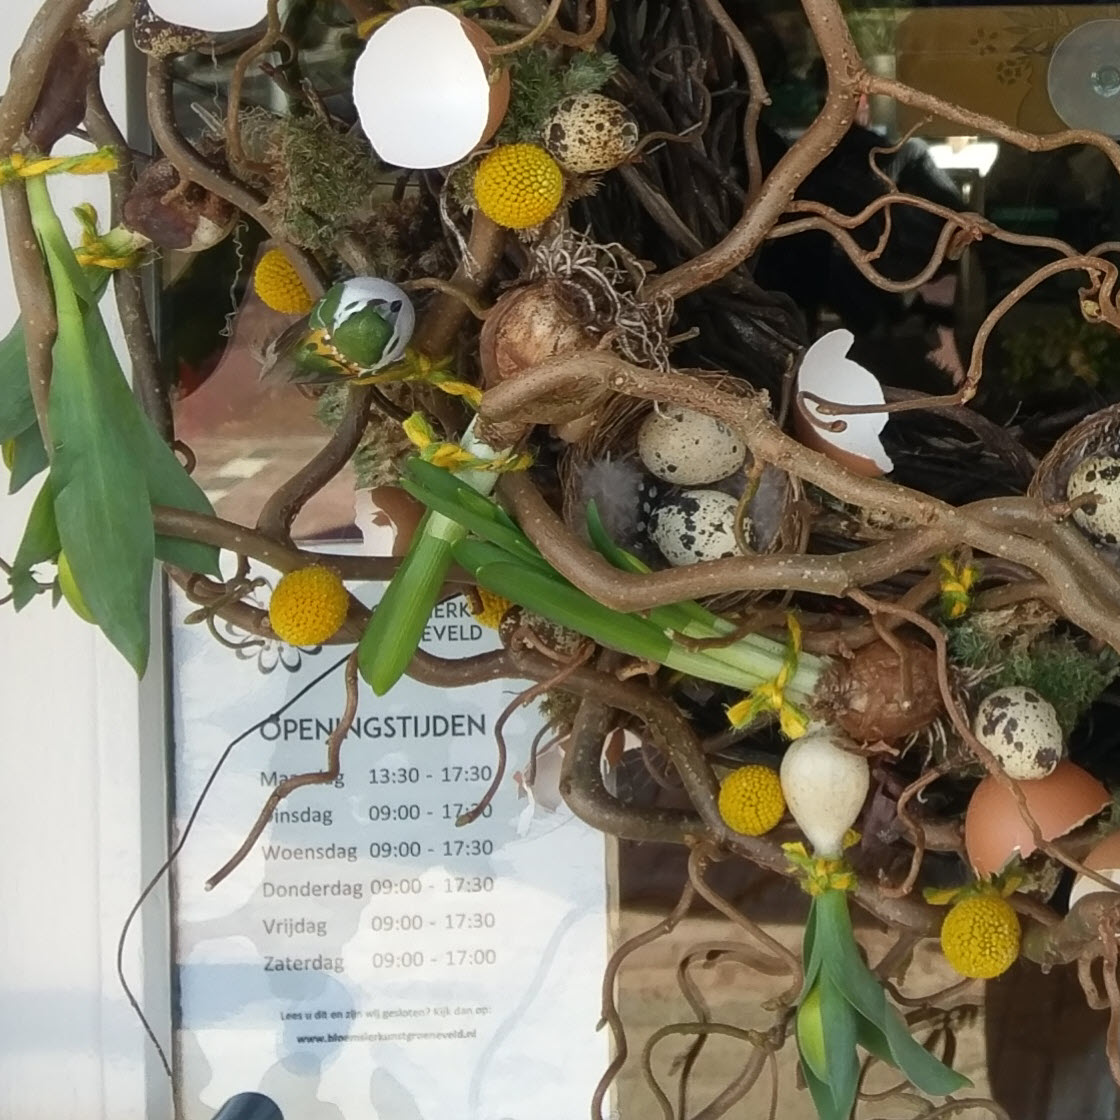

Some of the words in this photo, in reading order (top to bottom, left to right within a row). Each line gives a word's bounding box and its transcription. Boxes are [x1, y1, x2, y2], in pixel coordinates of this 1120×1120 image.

[368, 767, 419, 784] 13:30
[441, 765, 492, 782] 17:30
[269, 807, 333, 825] insdag
[368, 805, 420, 821] 09:00
[262, 843, 357, 862] Woensdag
[369, 842, 421, 858] 09:00
[442, 840, 493, 856] 17:30
[263, 880, 363, 899] Donderdag
[370, 880, 422, 895] 09:00
[444, 877, 494, 892] 17:30
[262, 918, 327, 938] Vrijdag
[371, 915, 423, 931] 09:00
[445, 913, 496, 929] 17:30
[264, 955, 344, 973] Zaterdag
[372, 952, 424, 968] 09:00
[446, 950, 497, 965] 17:00
